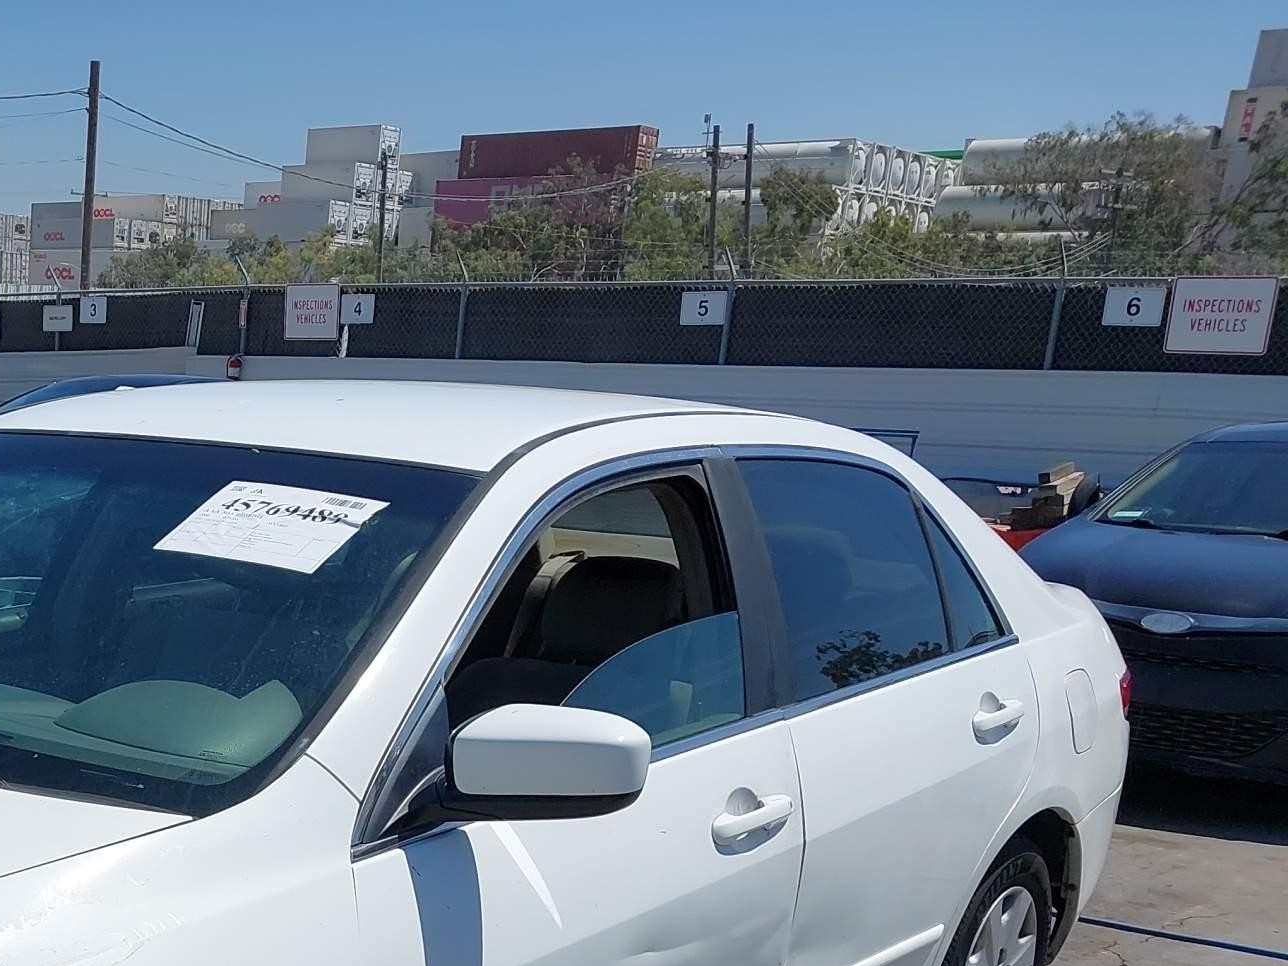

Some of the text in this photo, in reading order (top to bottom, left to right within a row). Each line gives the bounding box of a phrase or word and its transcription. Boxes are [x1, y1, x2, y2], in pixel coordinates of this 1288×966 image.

[93, 208, 115, 218] OOCL
[43, 231, 65, 241] OOCL
[89, 303, 97, 317] 3
[291, 299, 333, 311] INSPECTIONS
[353, 301, 363, 317] 4
[697, 300, 709, 317] 5
[1126, 296, 1142, 317] 6
[1182, 298, 1262, 313] INSPECTIONS
[296, 313, 327, 325] VEHICLES
[1190, 317, 1248, 333] VEHICLES
